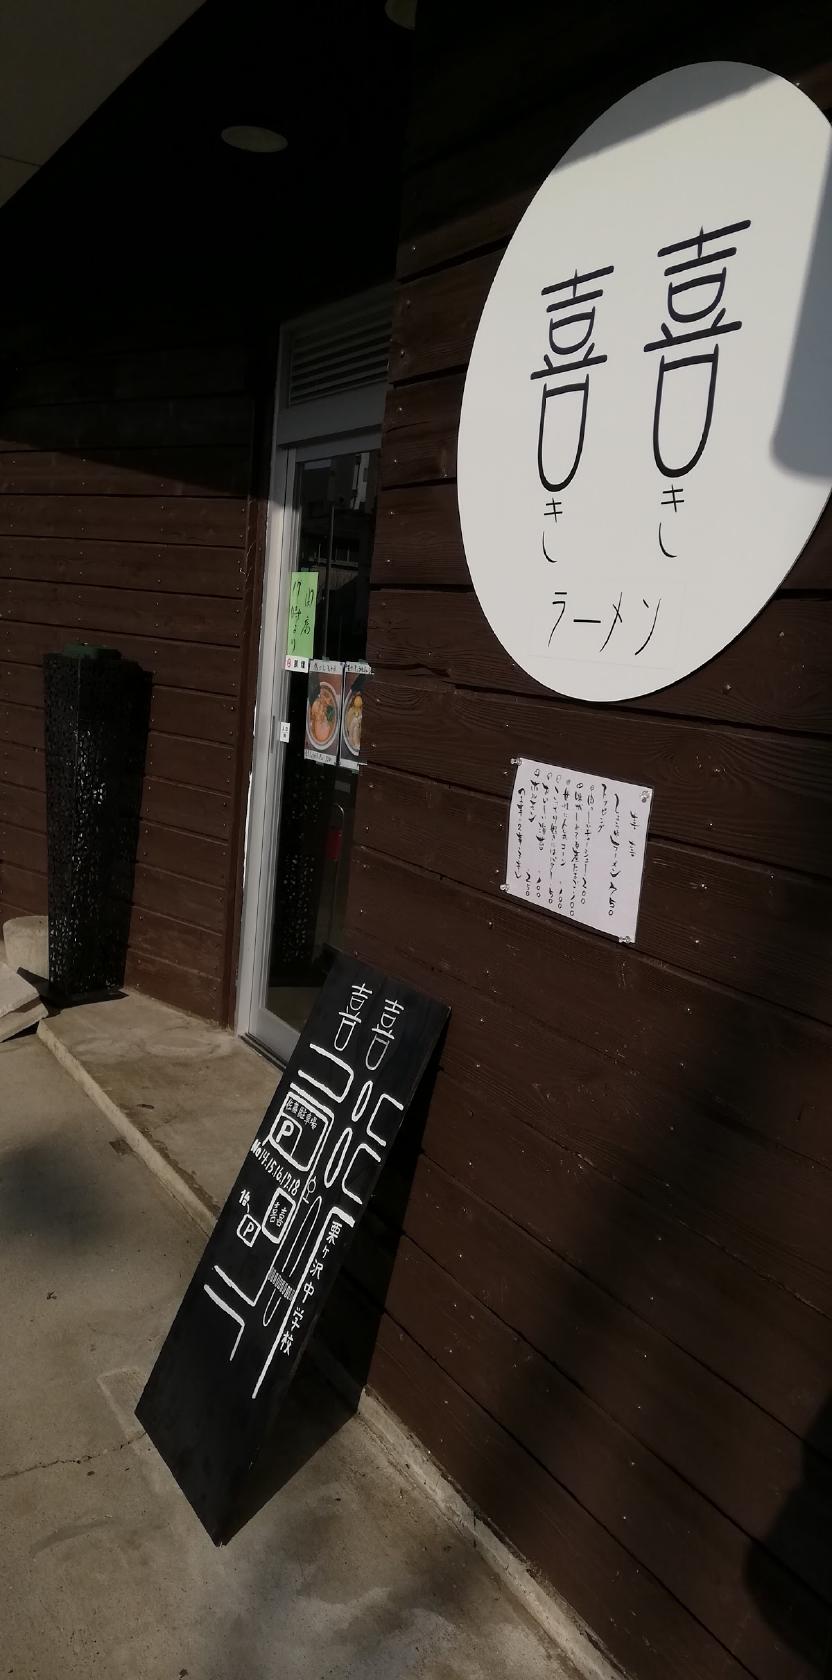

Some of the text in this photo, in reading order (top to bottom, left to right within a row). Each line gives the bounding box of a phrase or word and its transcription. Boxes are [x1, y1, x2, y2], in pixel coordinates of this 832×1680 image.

[547, 591, 662, 656] ラーメン
[276, 1120, 294, 1143] P
[243, 1222, 254, 1236] P
